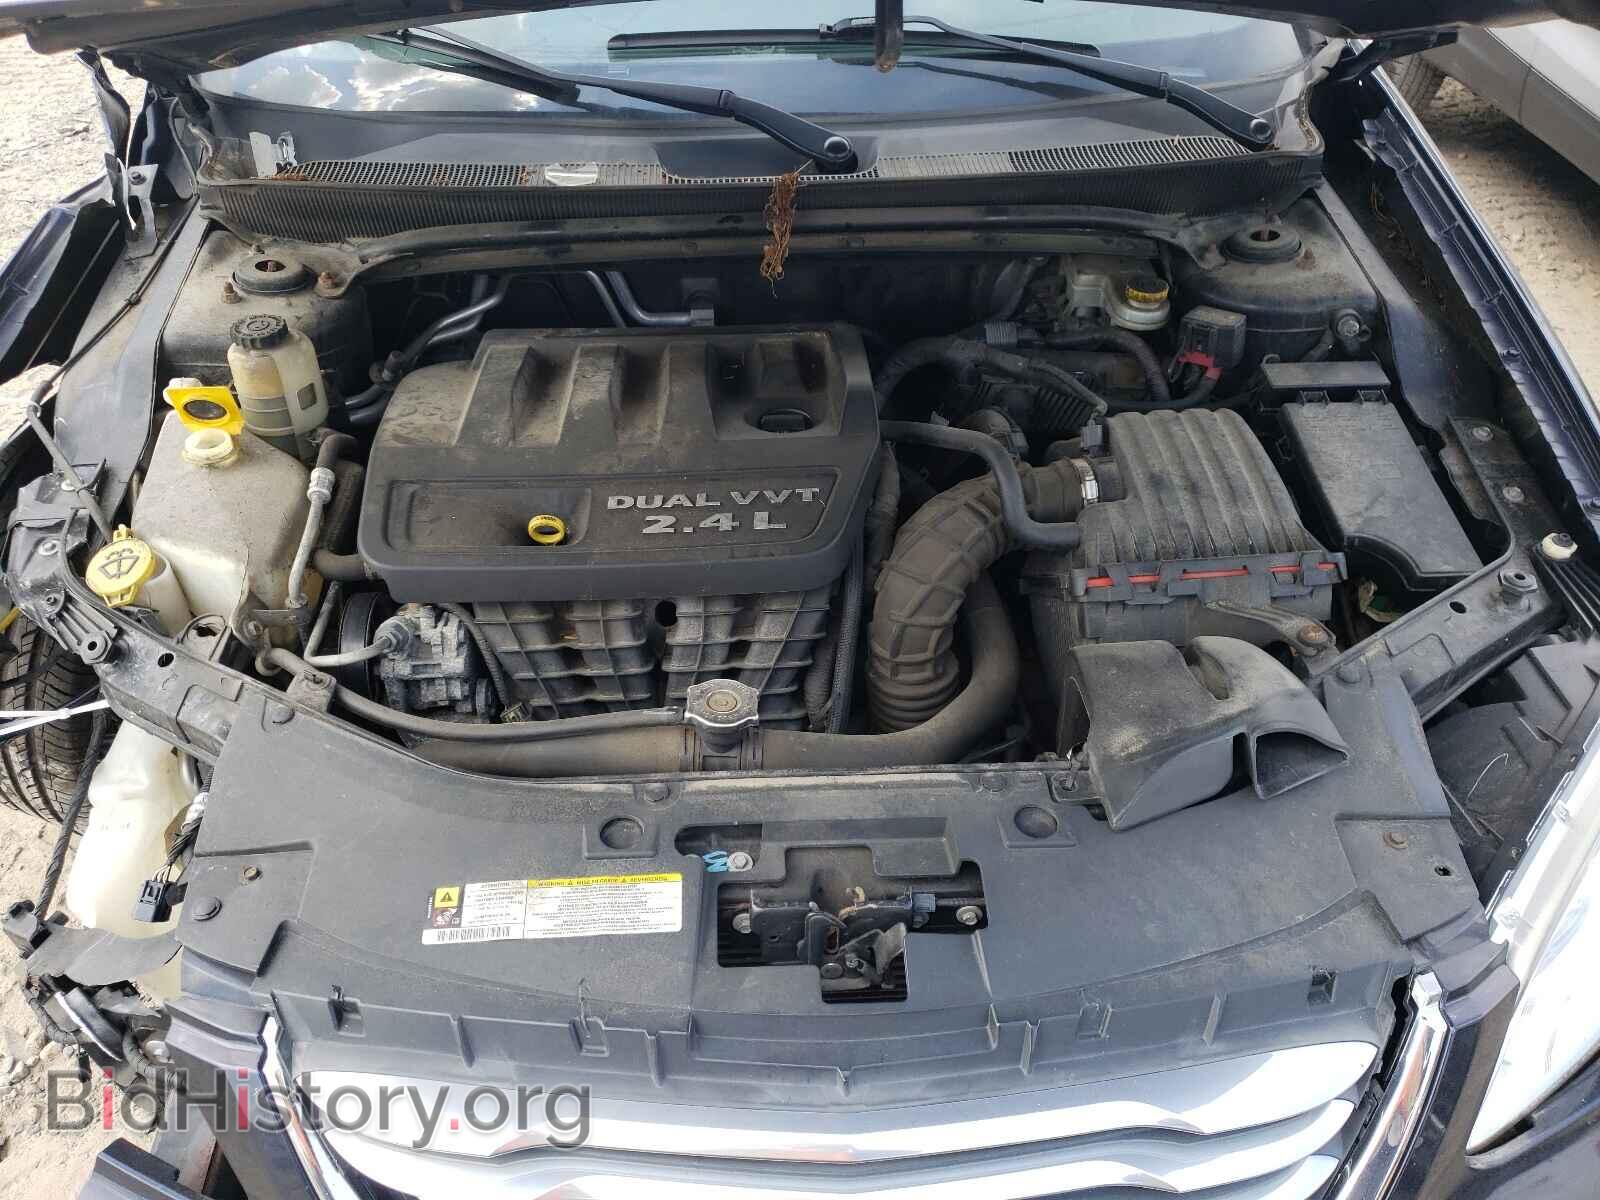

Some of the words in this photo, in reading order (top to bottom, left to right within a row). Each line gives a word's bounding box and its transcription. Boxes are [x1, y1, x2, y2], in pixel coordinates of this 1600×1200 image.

[607, 492, 721, 510] DUAL
[729, 487, 820, 506] VVT
[641, 512, 740, 535] 2.4
[753, 511, 787, 530] L
